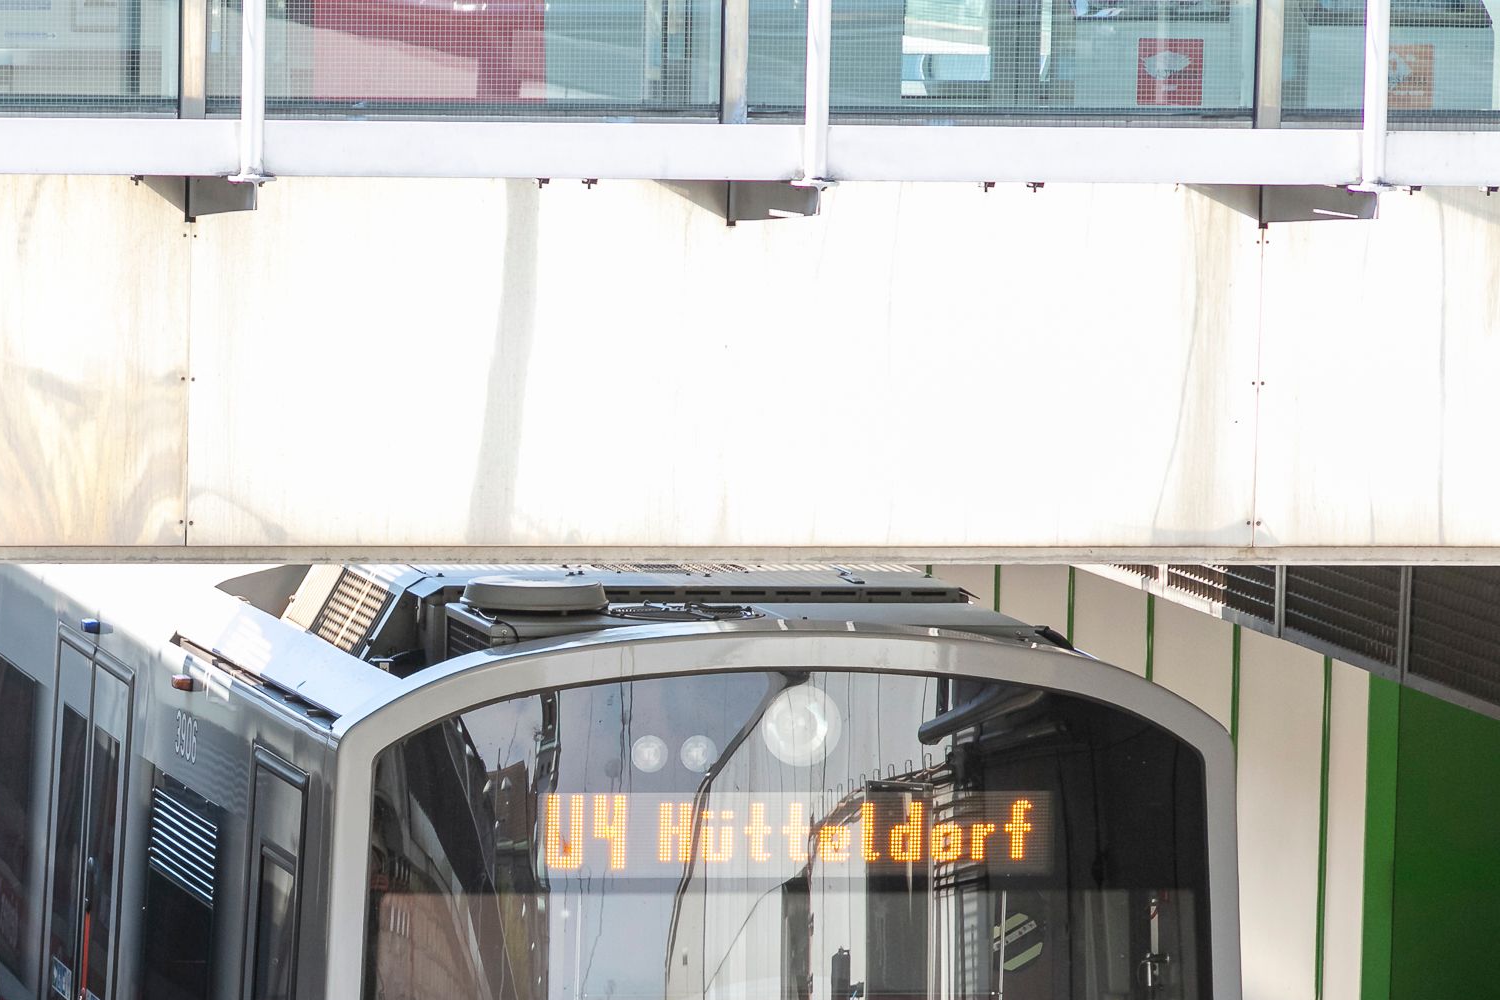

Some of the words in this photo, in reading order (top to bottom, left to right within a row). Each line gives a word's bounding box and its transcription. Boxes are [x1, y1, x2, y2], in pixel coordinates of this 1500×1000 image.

[175, 709, 198, 764] 3906
[544, 794, 627, 870] U4
[658, 798, 1035, 863] Hütteldorf
